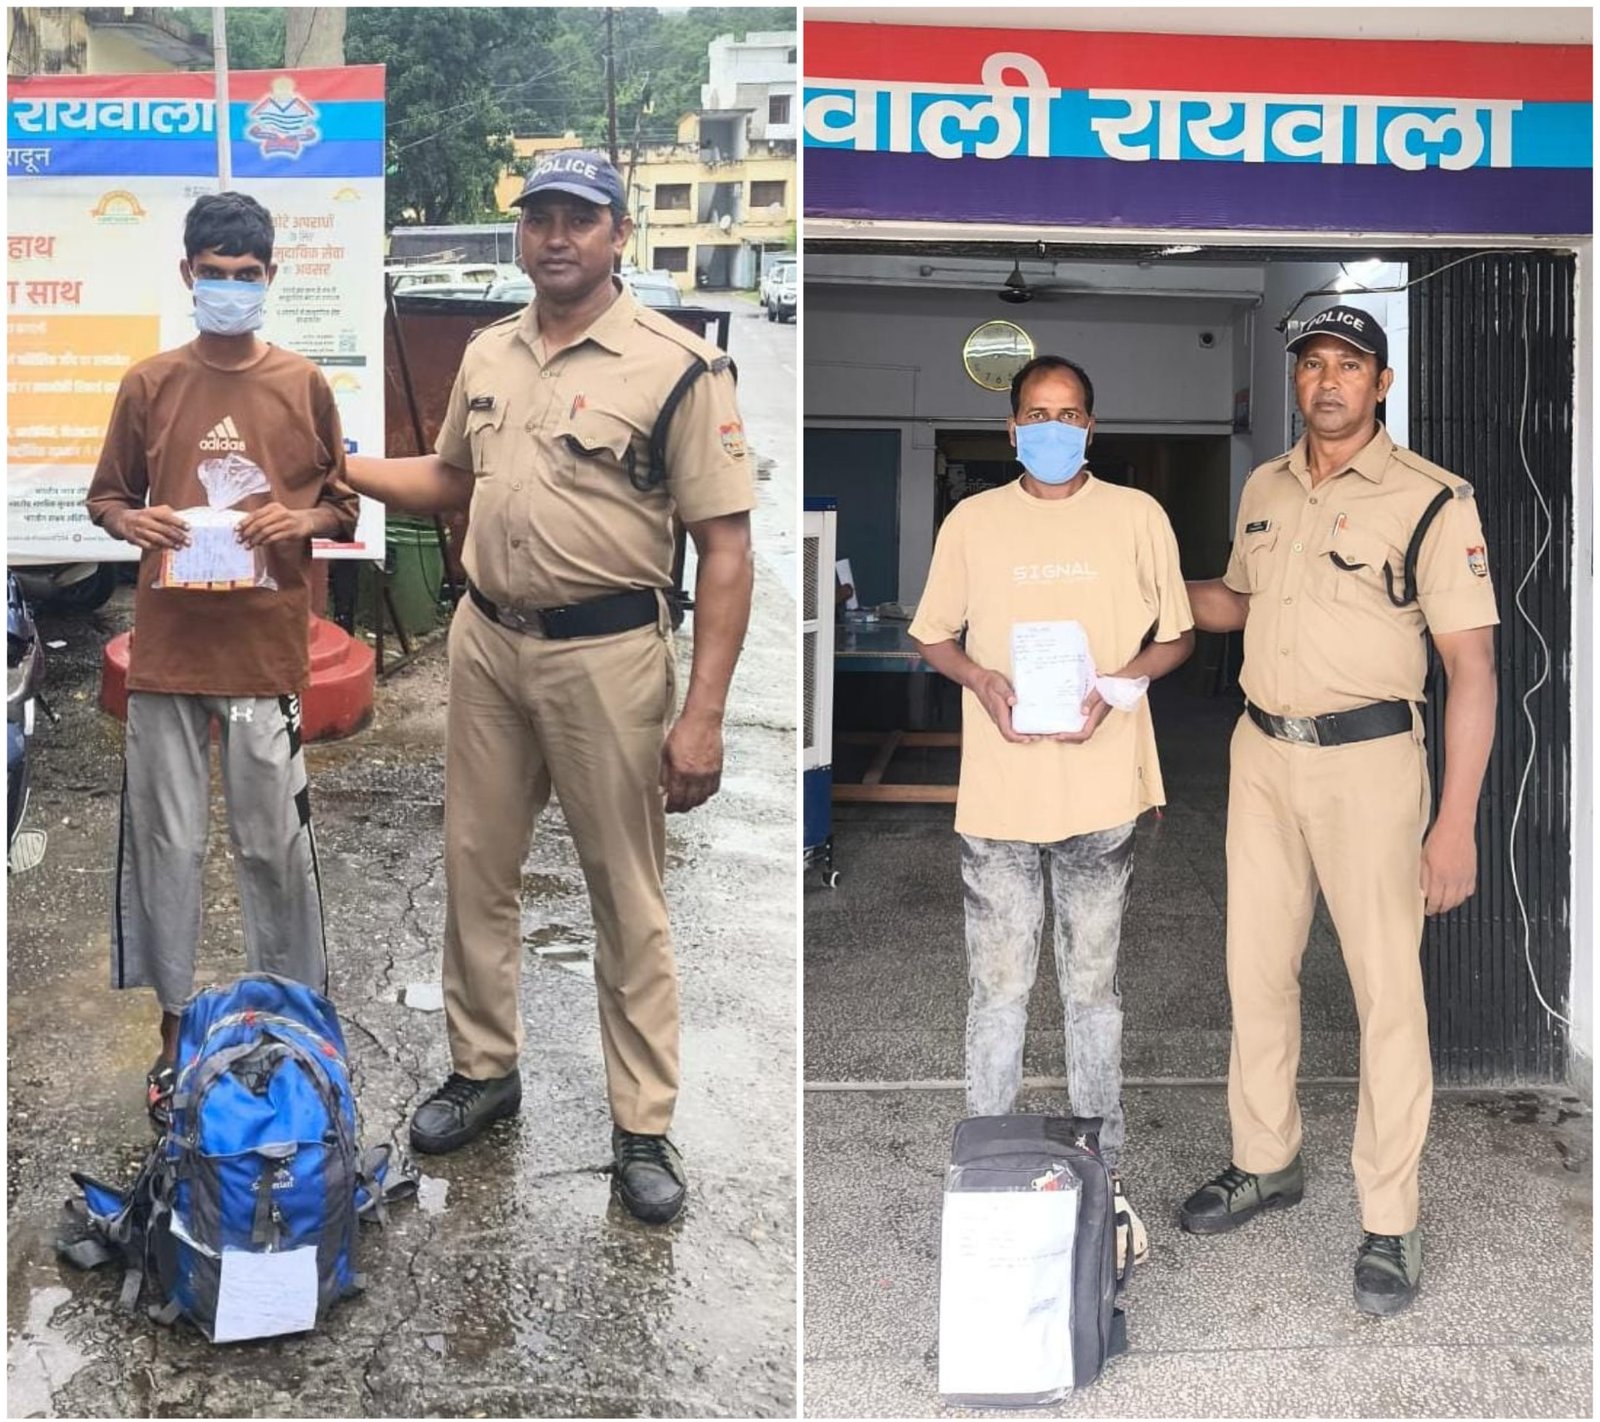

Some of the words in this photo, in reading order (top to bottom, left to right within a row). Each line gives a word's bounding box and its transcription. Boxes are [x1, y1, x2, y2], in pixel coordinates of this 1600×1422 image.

[13, 97, 217, 134] रायवाला
[803, 51, 1062, 160] वाली
[1087, 88, 1524, 171] रायवाला
[26, 281, 83, 305] साथ
[200, 438, 246, 451] adidas
[1013, 561, 1099, 580] SIGNAL
